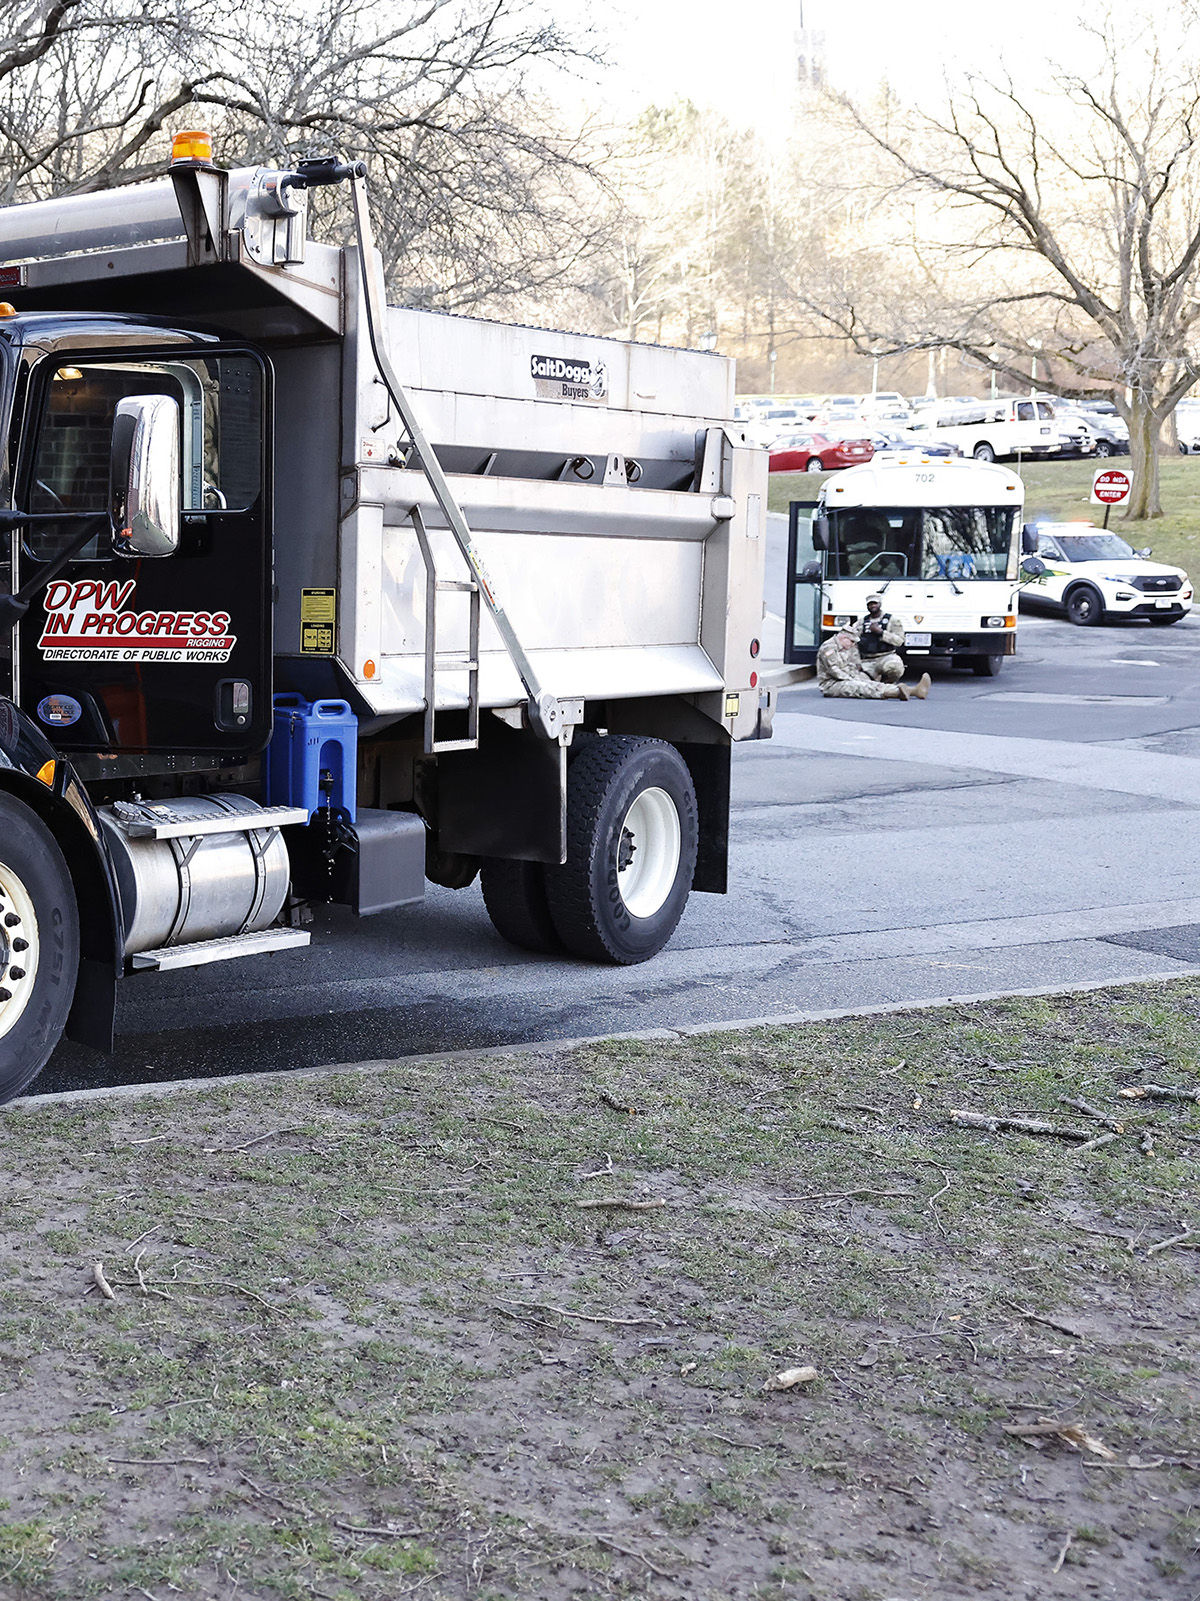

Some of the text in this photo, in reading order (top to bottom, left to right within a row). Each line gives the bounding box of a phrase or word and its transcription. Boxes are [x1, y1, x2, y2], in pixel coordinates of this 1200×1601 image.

[531, 356, 590, 384] SaltDogg
[562, 383, 589, 400] Buyers
[915, 473, 935, 483] 702
[45, 581, 134, 610] DPW
[45, 613, 228, 636] IN PROGRESS
[186, 638, 226, 648] RIGGING
[45, 649, 229, 661] DIRECTORATE OF PUBLIC WORKS
